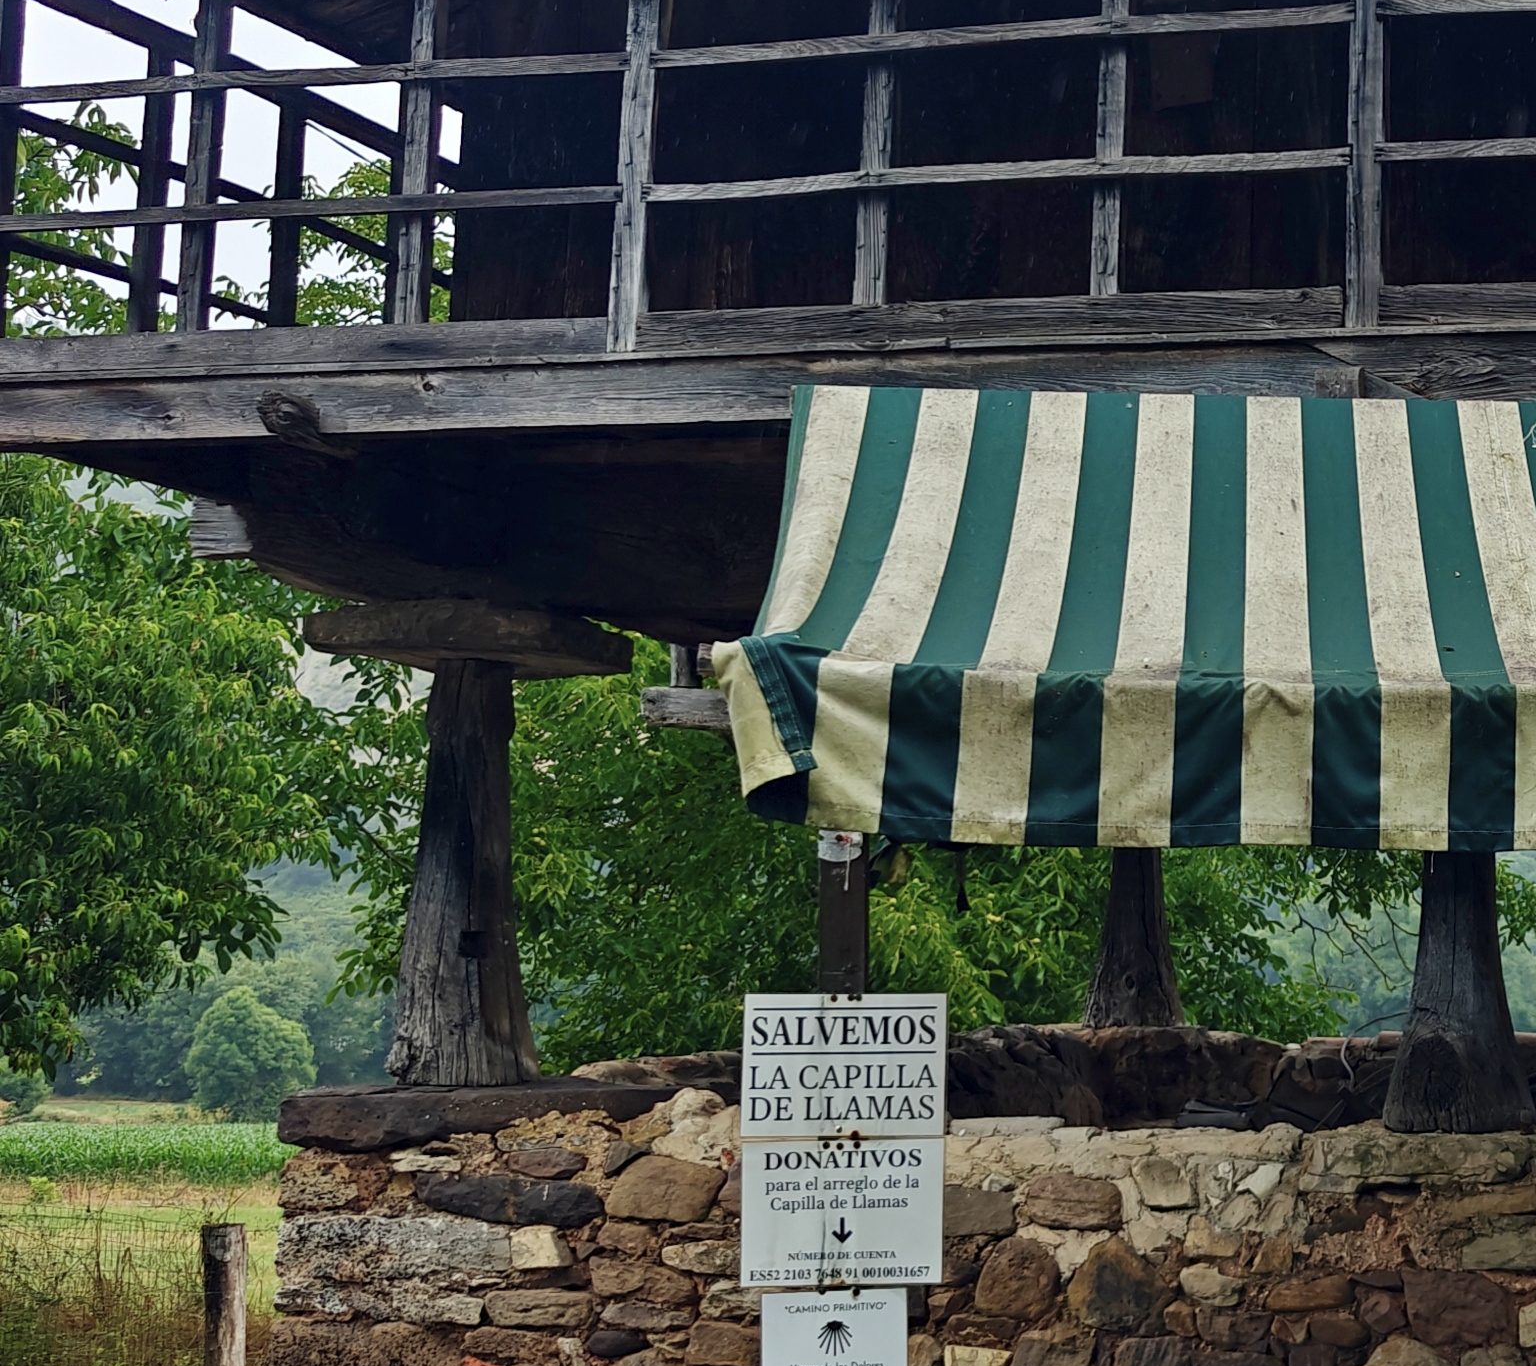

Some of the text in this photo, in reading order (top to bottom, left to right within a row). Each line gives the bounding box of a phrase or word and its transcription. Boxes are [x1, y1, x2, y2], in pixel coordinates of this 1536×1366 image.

[751, 1015, 936, 1046] SALVEMOS
[749, 1064, 938, 1090] LA CAPILLA
[749, 1095, 935, 1121] DE LLAMAS
[764, 1149, 922, 1171] DONATIVOS
[765, 1174, 920, 1195] para el arreglo de la
[770, 1195, 908, 1214] Capilla de Llamas
[788, 1250, 897, 1262] NÚMERO DE CUENTA
[749, 1270, 781, 1282] ES52
[784, 1268, 811, 1280] 2103
[845, 1267, 859, 1279] 91
[862, 1266, 930, 1278] 0010031657
